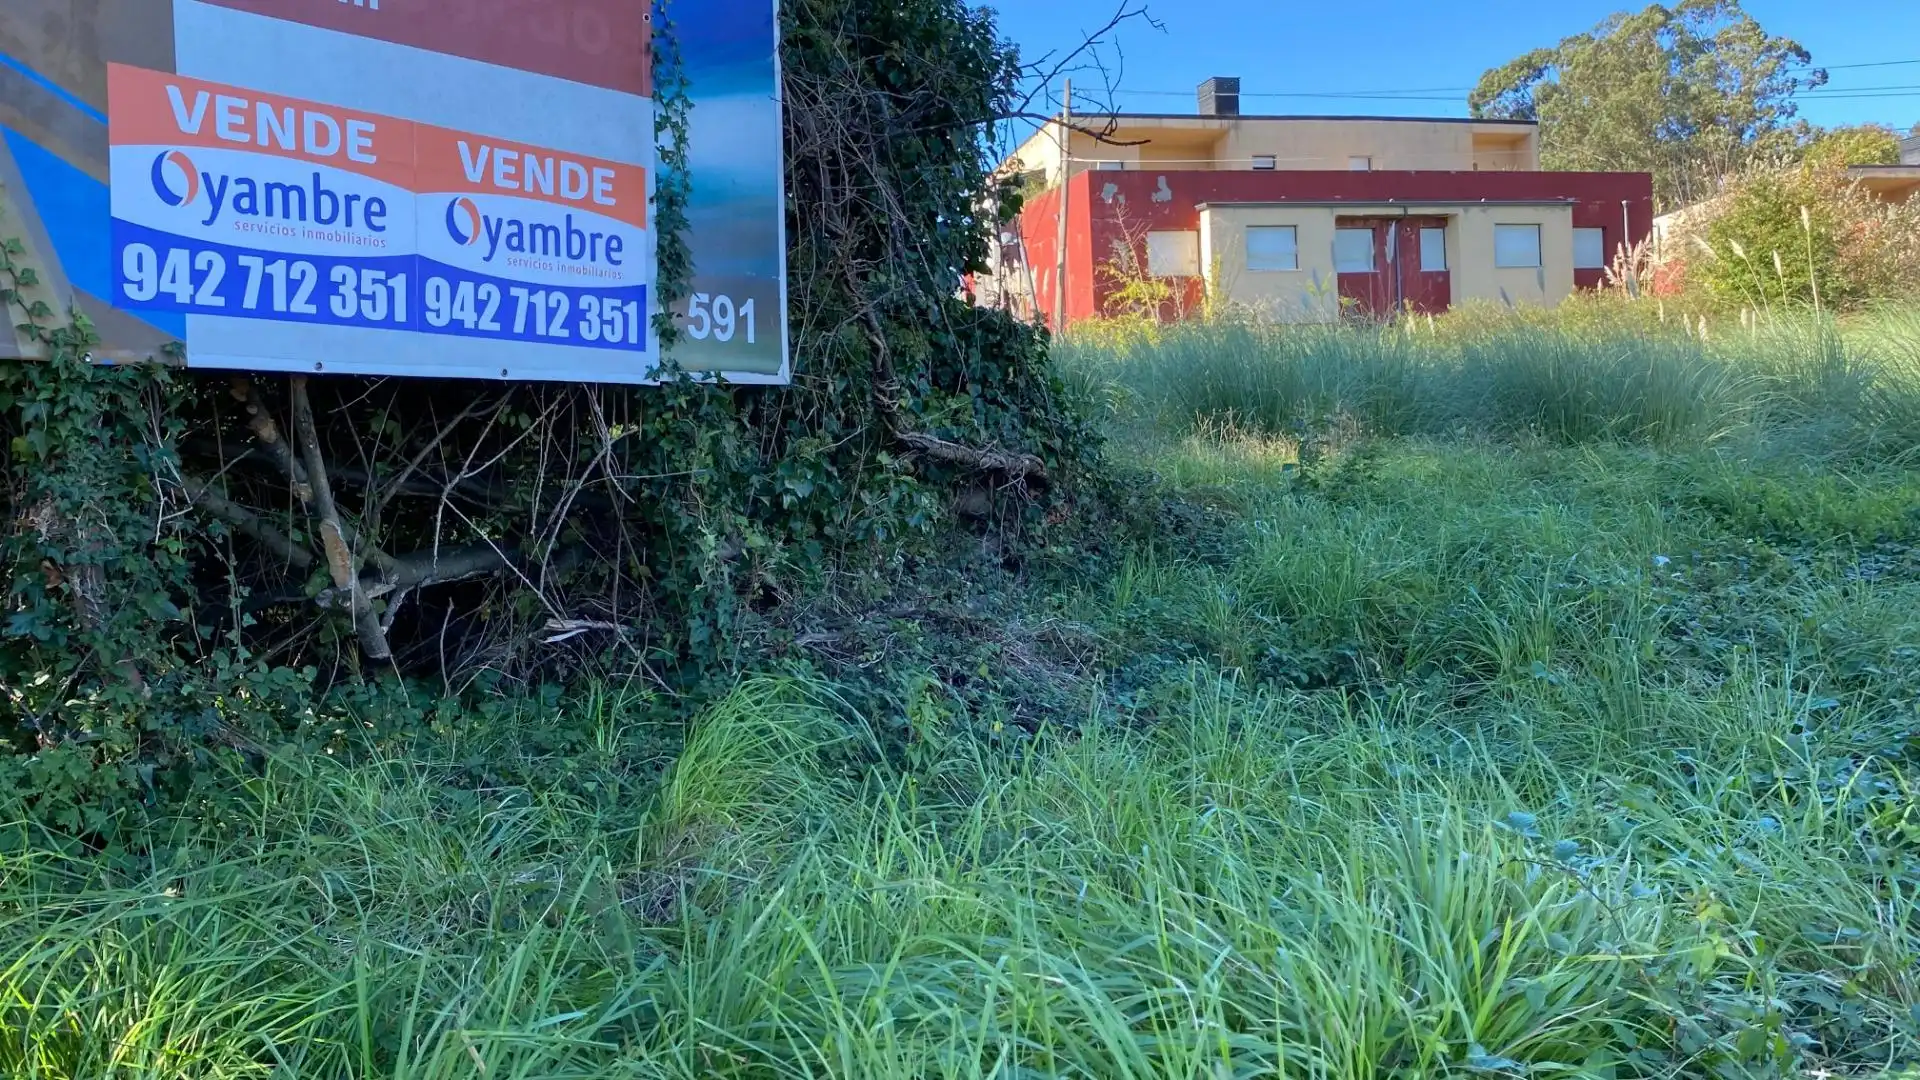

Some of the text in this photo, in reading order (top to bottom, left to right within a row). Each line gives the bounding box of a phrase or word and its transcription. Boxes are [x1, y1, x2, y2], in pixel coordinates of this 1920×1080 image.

[165, 84, 377, 165] VENDE
[151, 150, 387, 232] Oyambre
[456, 140, 617, 207] VENDE
[234, 219, 387, 248] servicios inmobiliarios
[445, 196, 624, 266] Oyambre
[122, 242, 408, 322] 942 712 351
[506, 256, 624, 280] servicios inmobiliarios
[424, 276, 638, 345] 942 712 351
[686, 292, 756, 344] 591
